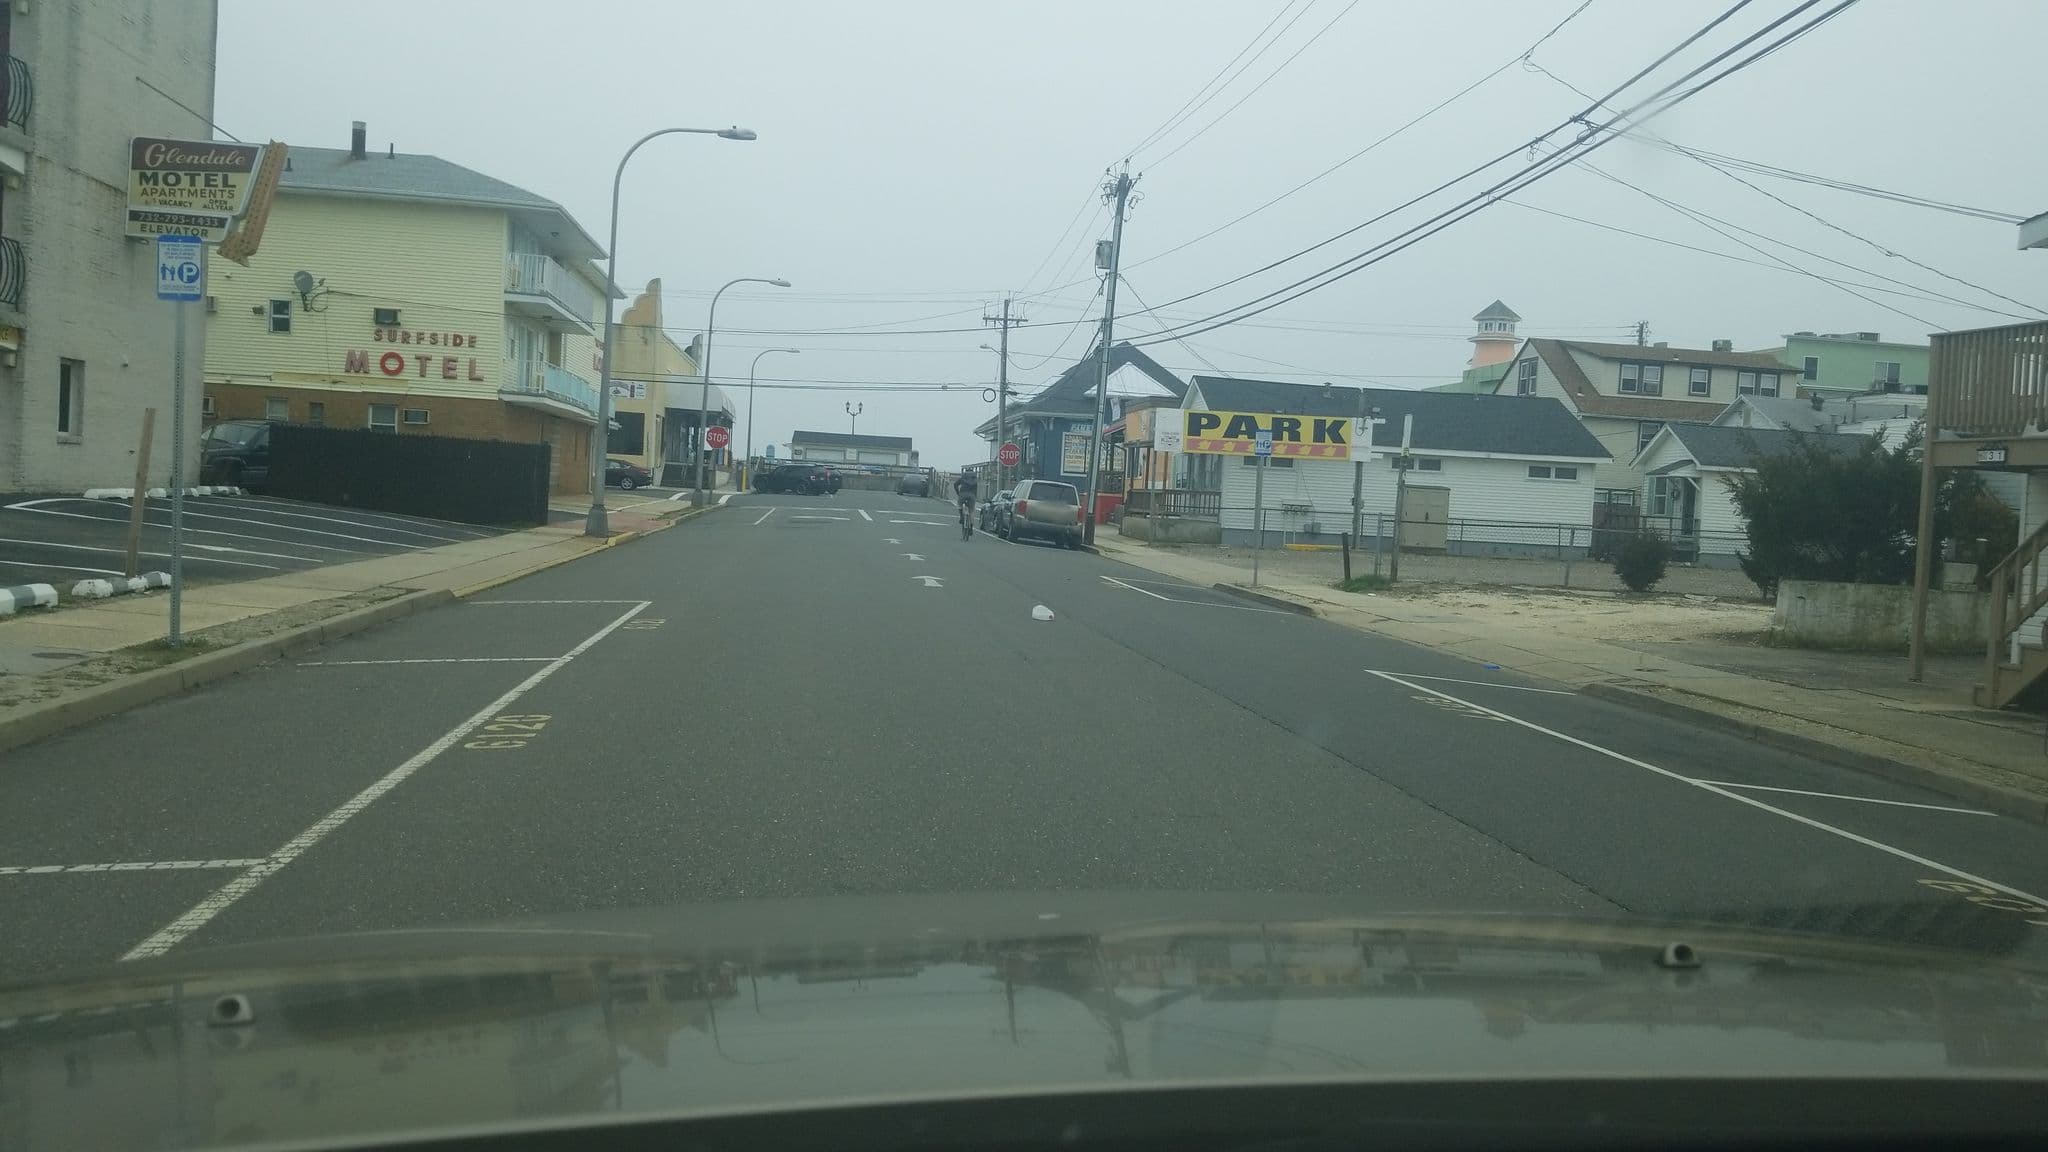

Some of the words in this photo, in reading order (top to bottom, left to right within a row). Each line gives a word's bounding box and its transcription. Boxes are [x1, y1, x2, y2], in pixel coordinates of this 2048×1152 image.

[144, 143, 244, 167] Glendale
[139, 171, 236, 188] MOTEL
[140, 188, 235, 199] APARTMENTS
[159, 199, 192, 208] VACANCY
[140, 223, 208, 237] ELEVATOR
[374, 328, 477, 348] SURFSIDE
[344, 349, 485, 381] MOTEL
[1187, 412, 1347, 444] PARK
[707, 432, 728, 442] STOP
[1000, 450, 1020, 460] STOP
